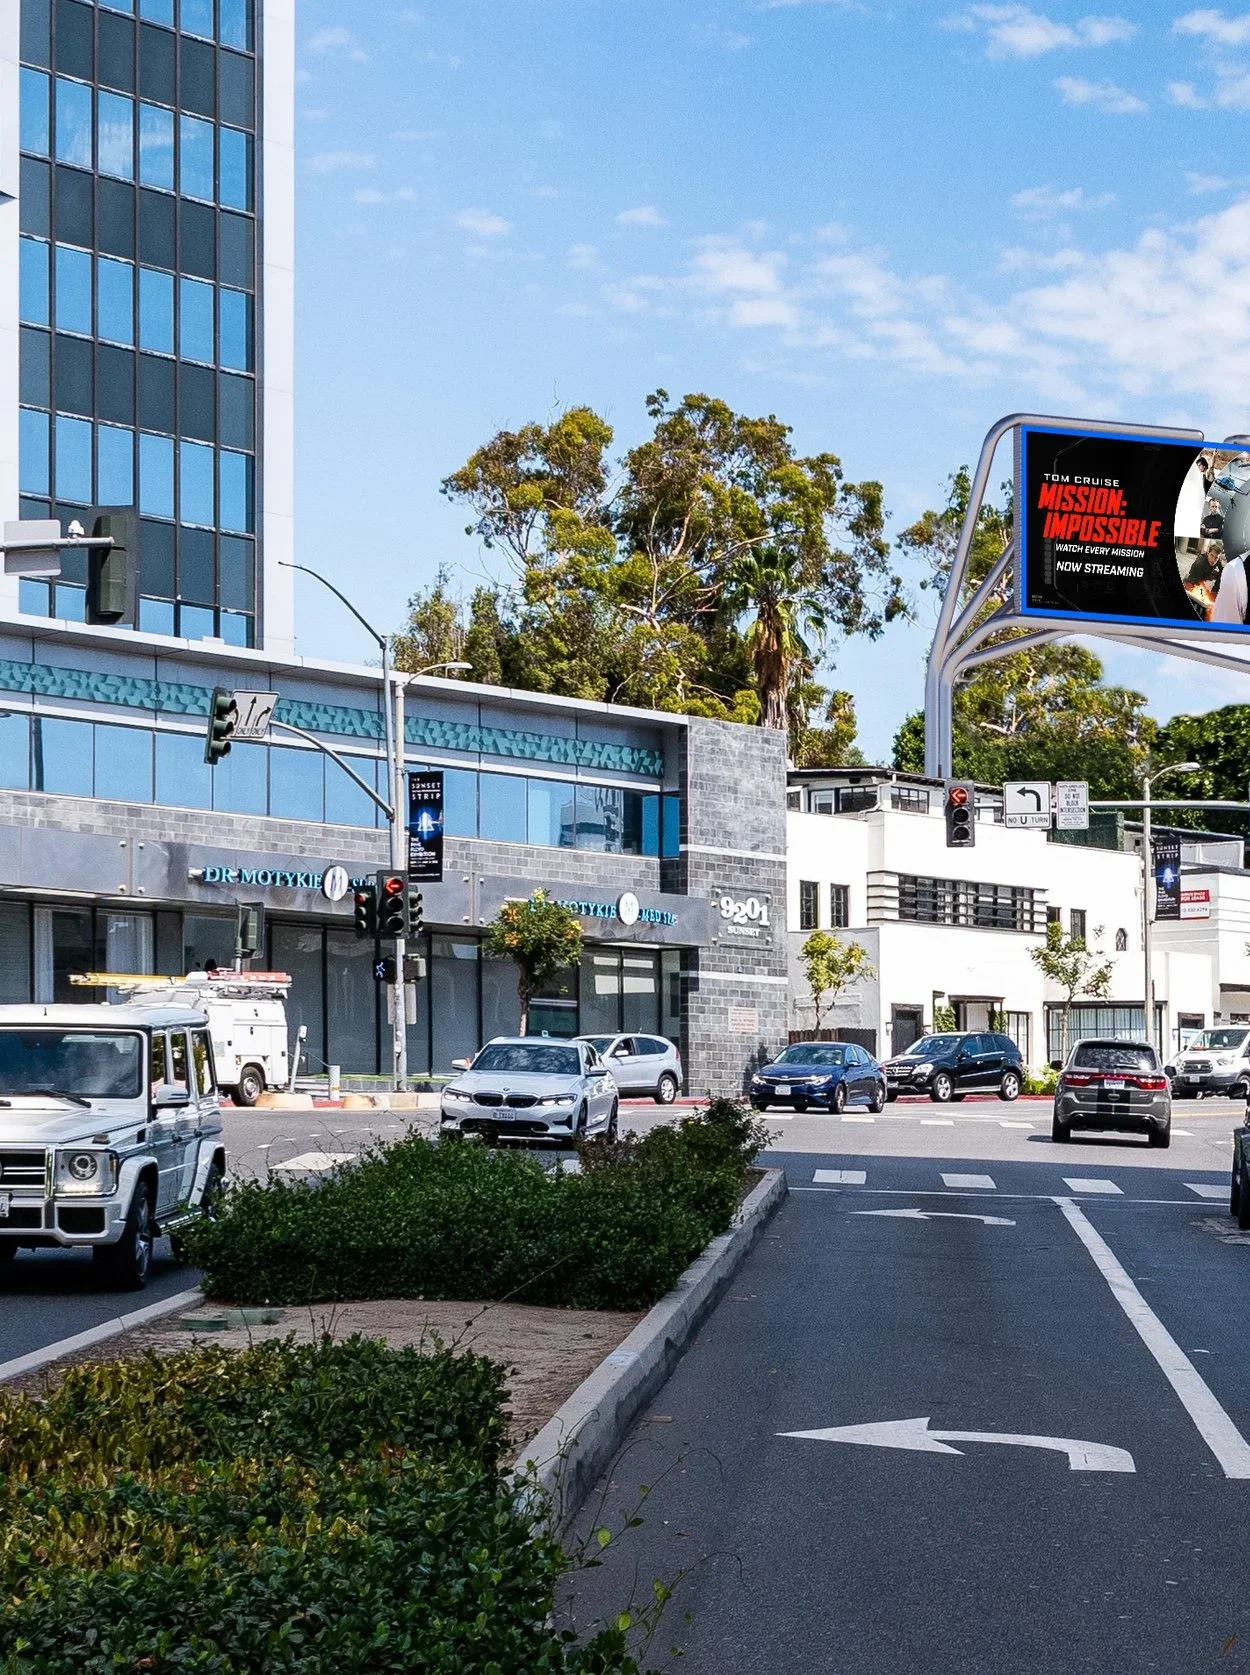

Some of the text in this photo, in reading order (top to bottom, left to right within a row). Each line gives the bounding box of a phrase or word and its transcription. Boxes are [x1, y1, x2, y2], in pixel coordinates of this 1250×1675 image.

[1043, 473, 1120, 487] TOM CRUISE
[1037, 482, 1128, 516] MISSION:
[1042, 511, 1162, 548] IMPOSSIBLE
[1055, 543, 1145, 558] WATCH EVERY MISSION
[1056, 560, 1144, 578] NOW STREAMING
[1020, 816, 1027, 825] U
[204, 866, 233, 883] DR
[719, 895, 770, 927] 9201
[727, 927, 761, 938] SUNSET
